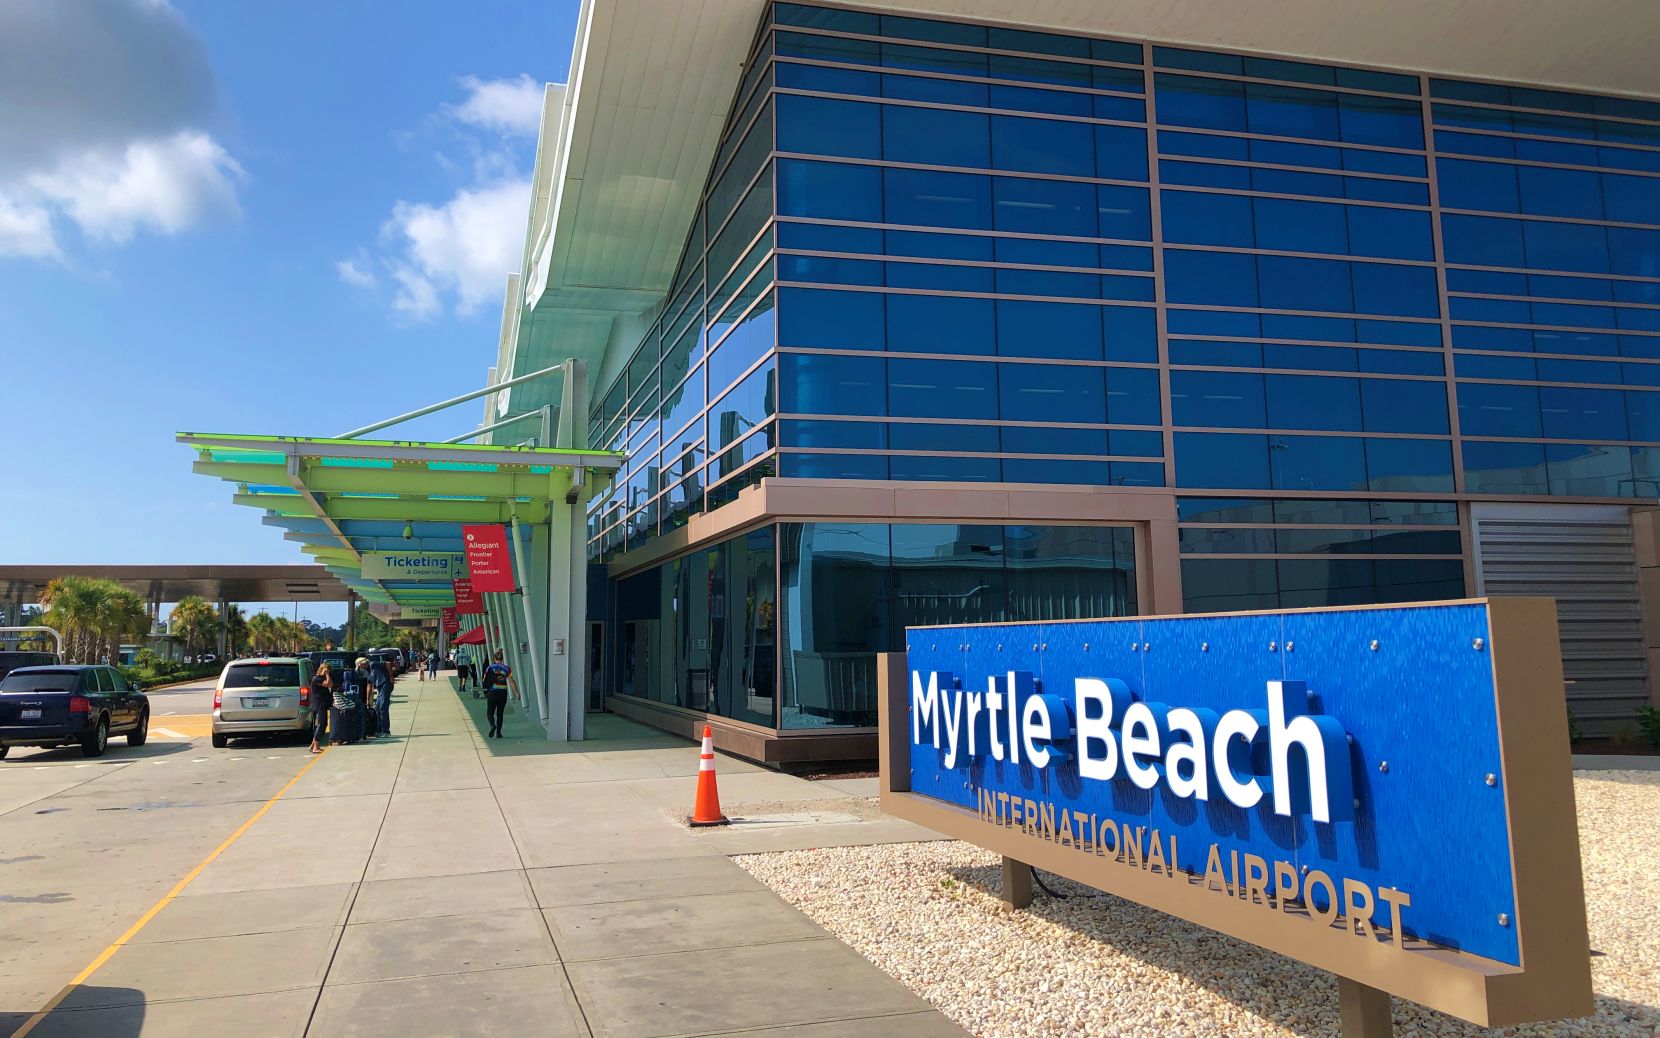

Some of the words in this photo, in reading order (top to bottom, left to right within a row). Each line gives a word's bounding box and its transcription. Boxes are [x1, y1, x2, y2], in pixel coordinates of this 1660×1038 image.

[384, 556, 448, 568] Ticketing
[912, 670, 1051, 769] Myrtle
[1074, 677, 1330, 824] Beach
[977, 787, 1189, 880] INTERNATIONAL
[1203, 842, 1411, 949] AIRPORT
